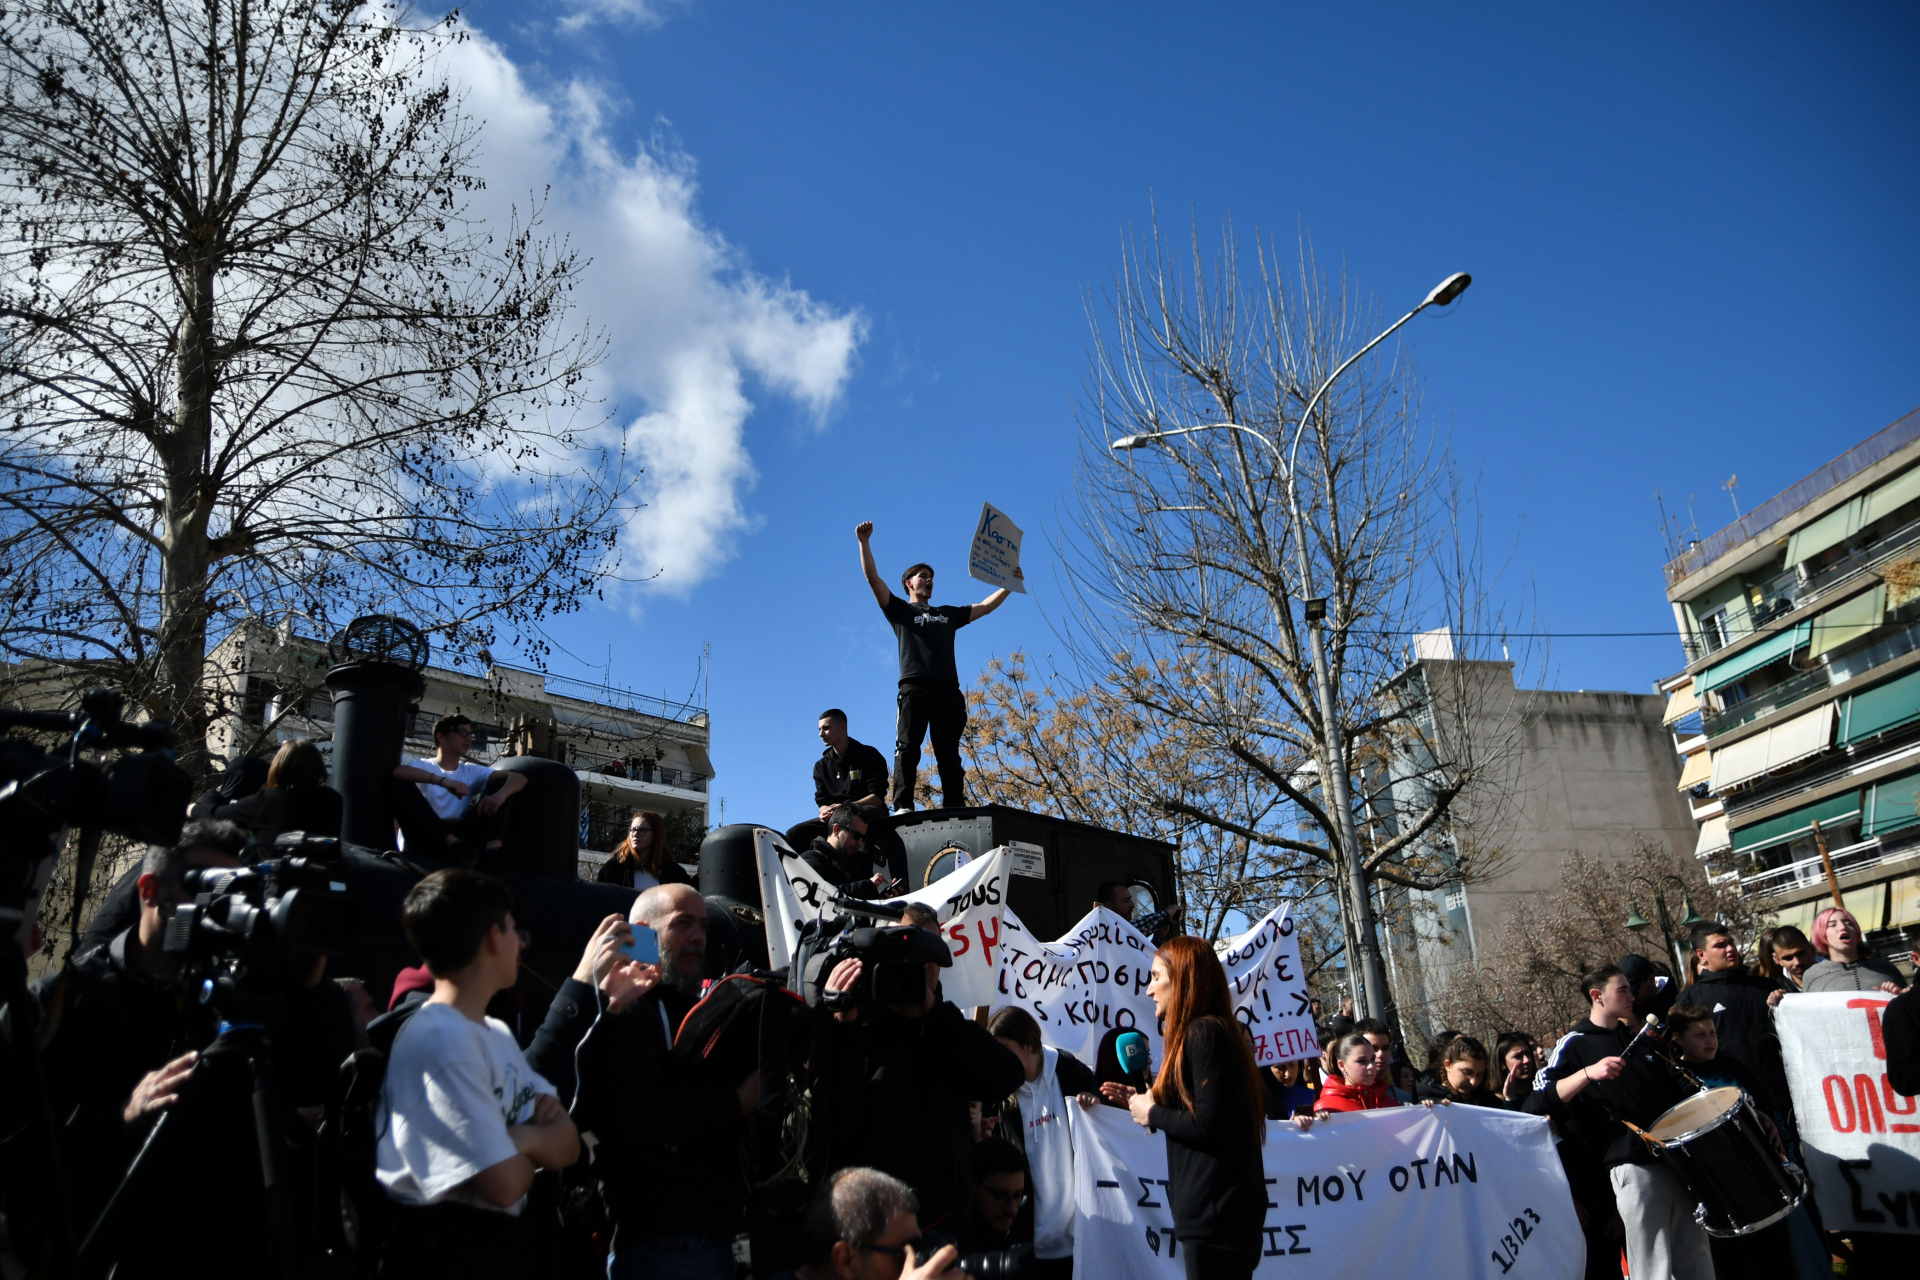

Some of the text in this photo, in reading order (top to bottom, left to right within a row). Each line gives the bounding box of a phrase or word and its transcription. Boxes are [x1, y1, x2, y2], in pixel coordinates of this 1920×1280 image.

[1298, 1170, 1366, 1207] ΜΟΥ
[1389, 1152, 1477, 1192] ΟΤΑΝ
[1491, 1208, 1541, 1274] 1/3/23
